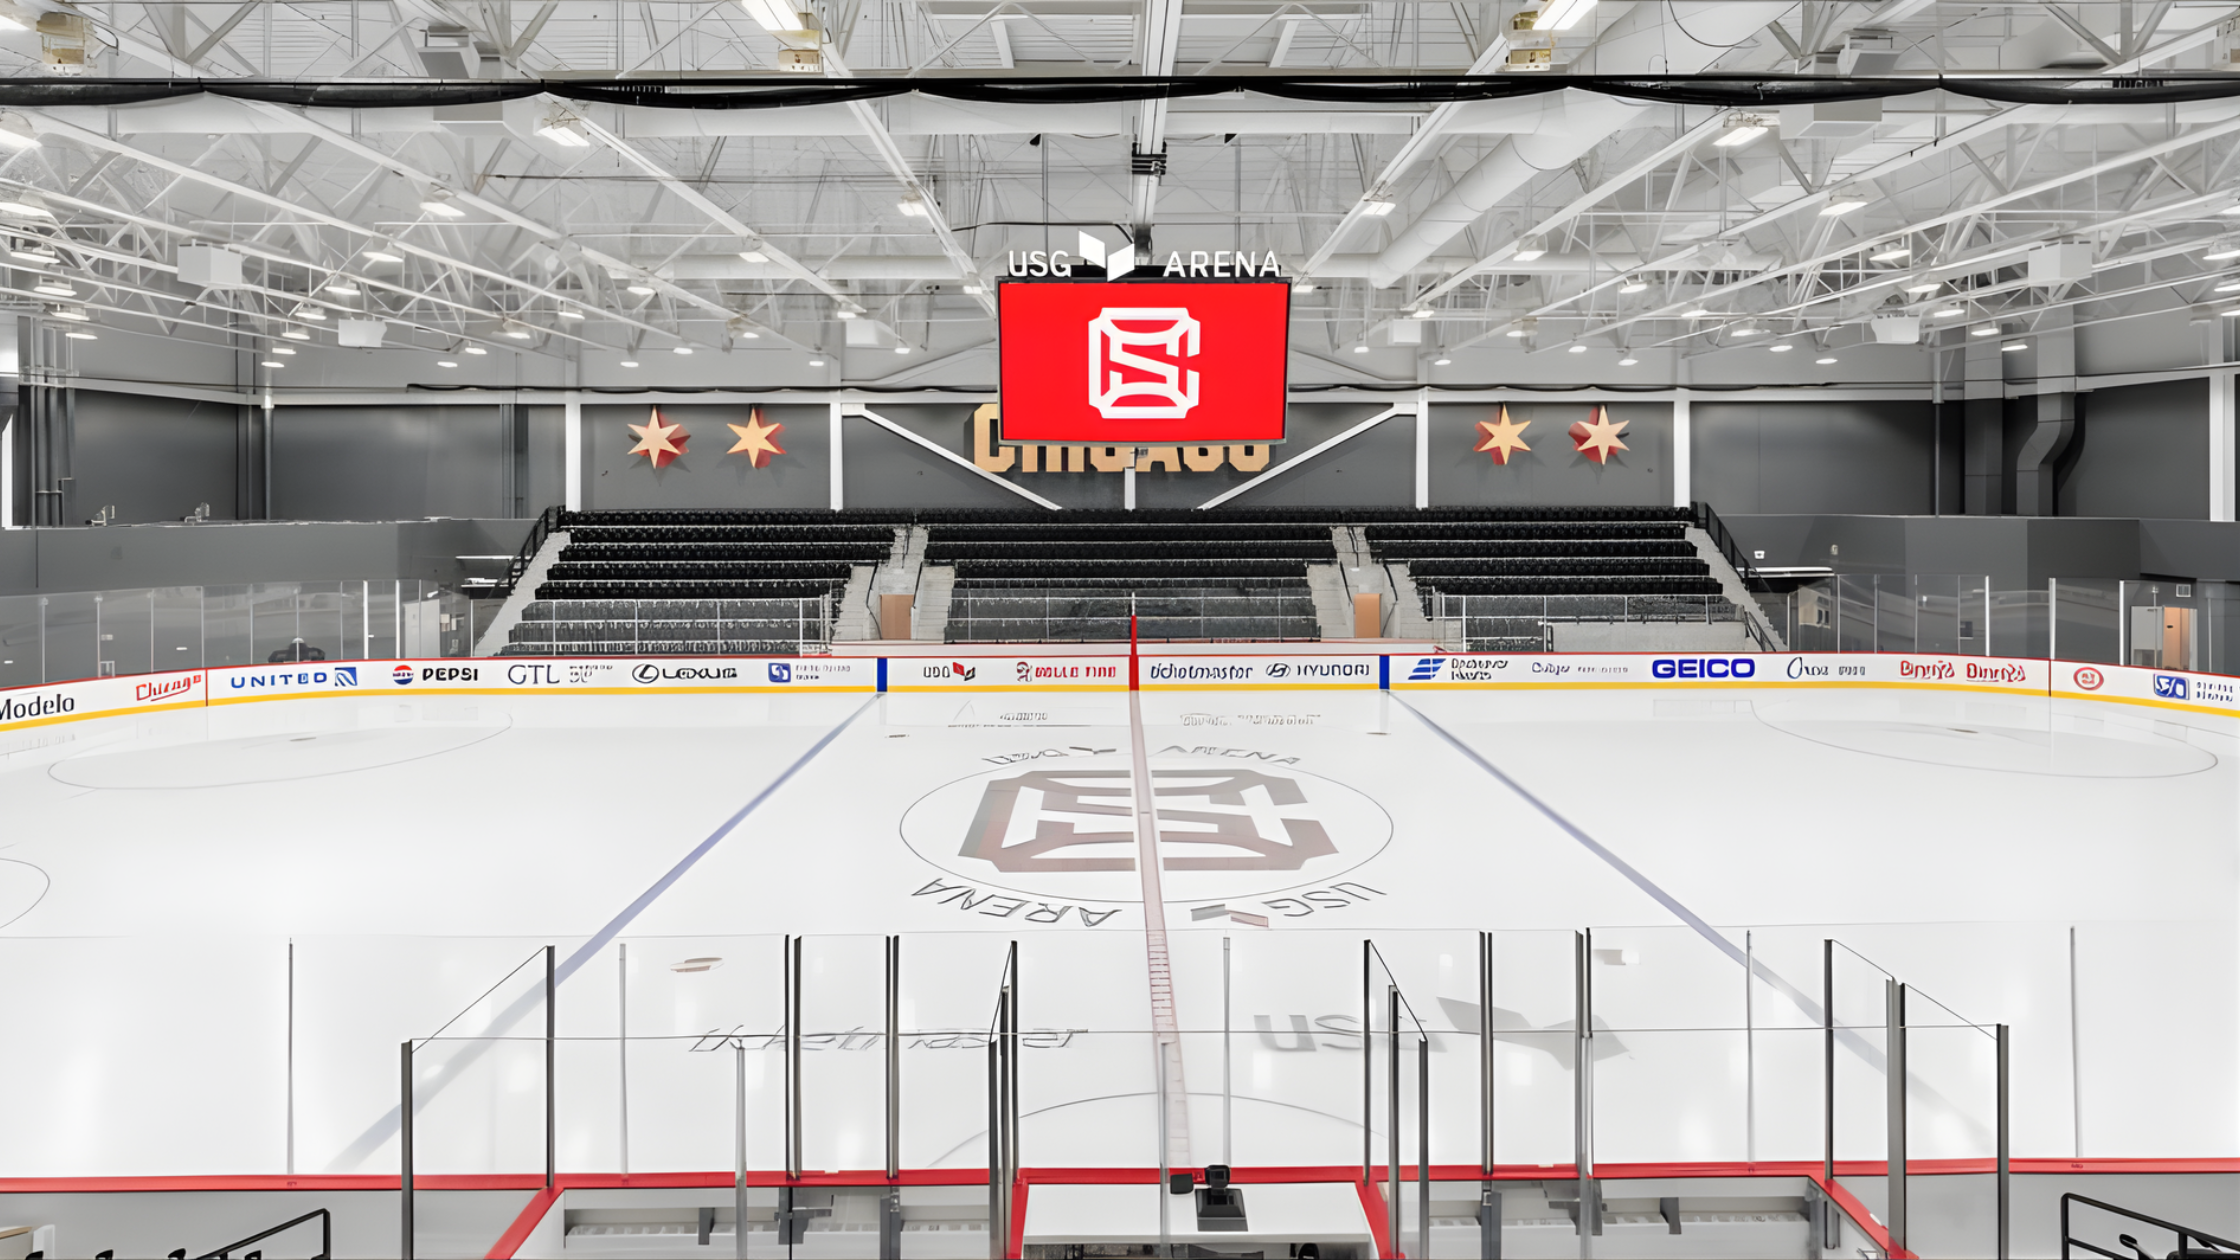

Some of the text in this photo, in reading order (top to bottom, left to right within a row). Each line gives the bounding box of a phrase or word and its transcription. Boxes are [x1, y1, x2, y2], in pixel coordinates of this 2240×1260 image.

[1008, 250, 1282, 278] USG ARENA
[422, 667, 478, 681] PEPSI
[508, 664, 560, 685] GTL
[1651, 658, 1755, 679] GEICO
[231, 672, 328, 689] UNITED
[0, 693, 75, 720] Modelo
